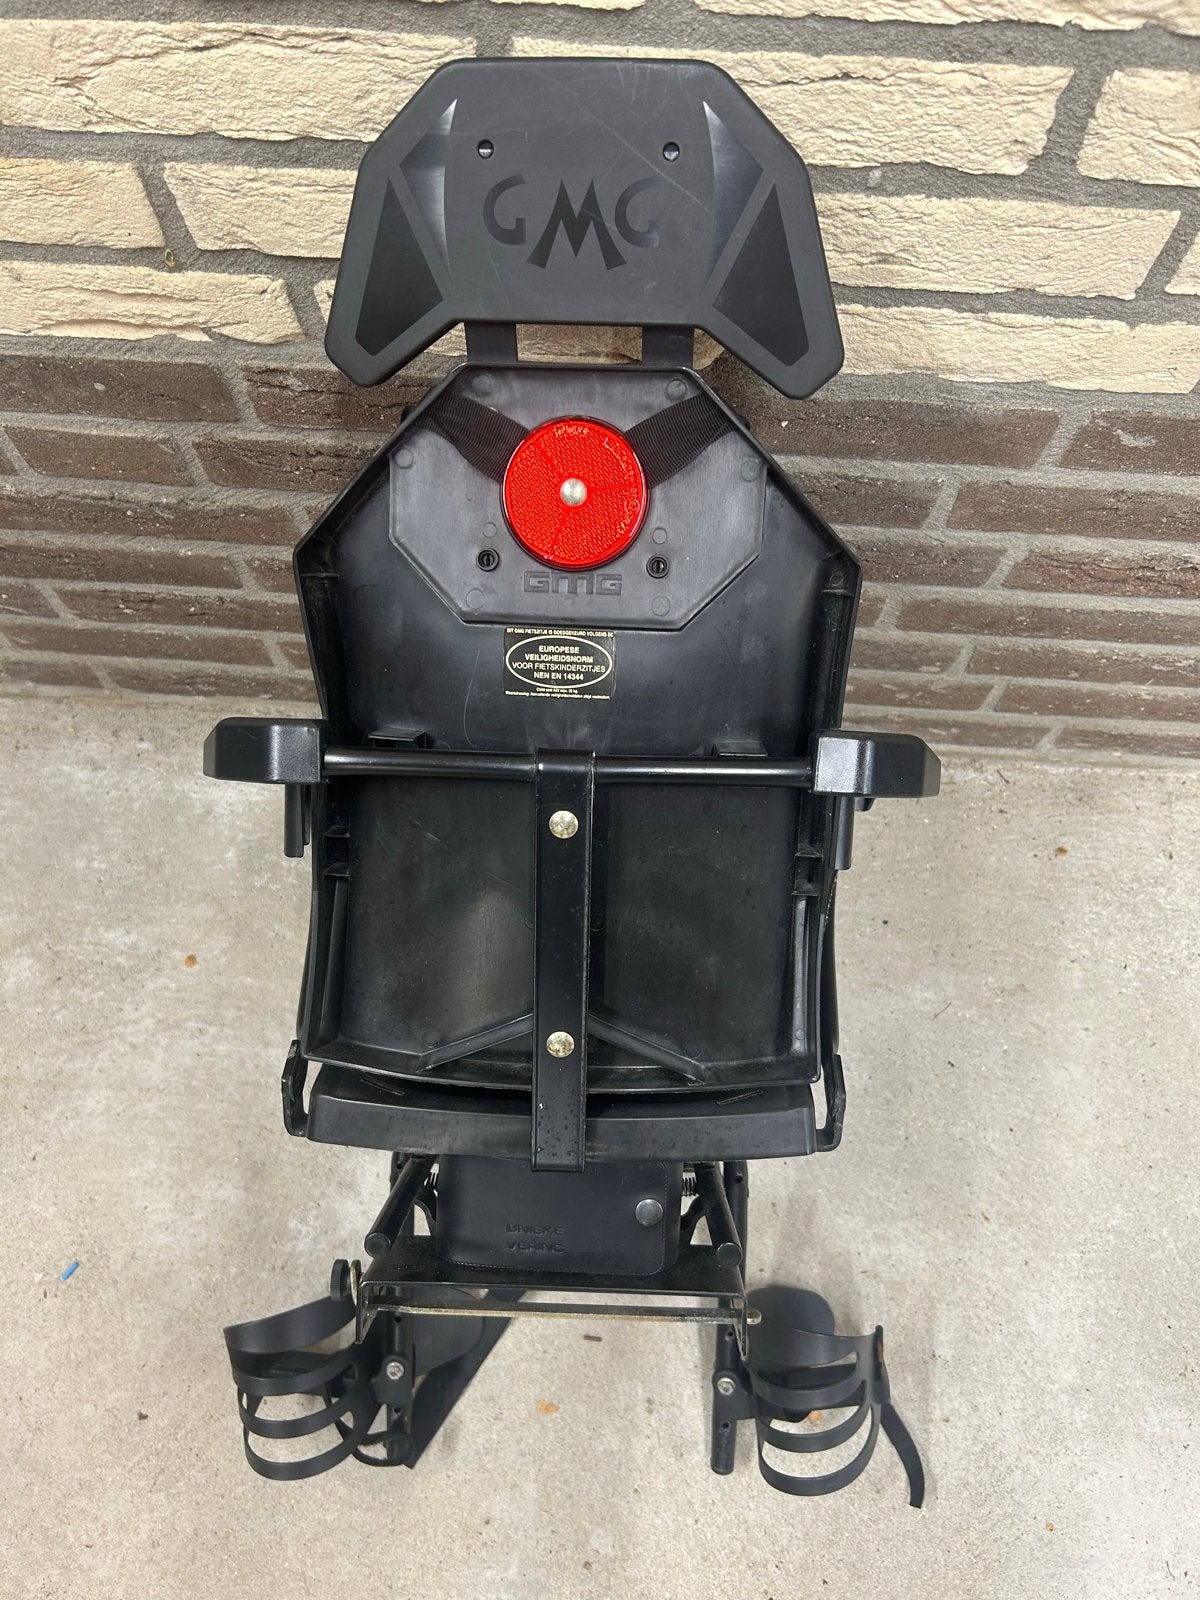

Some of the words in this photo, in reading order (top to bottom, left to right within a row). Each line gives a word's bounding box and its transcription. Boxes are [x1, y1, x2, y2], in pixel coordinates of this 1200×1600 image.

[483, 174, 660, 270] GMG
[539, 645, 580, 654] EUROPESE
[525, 653, 594, 663] VEILIGHEIDSNORM
[512, 662, 533, 670] VOOR
[535, 662, 606, 673] FIETSKINDERZITJES
[551, 672, 562, 680] EN
